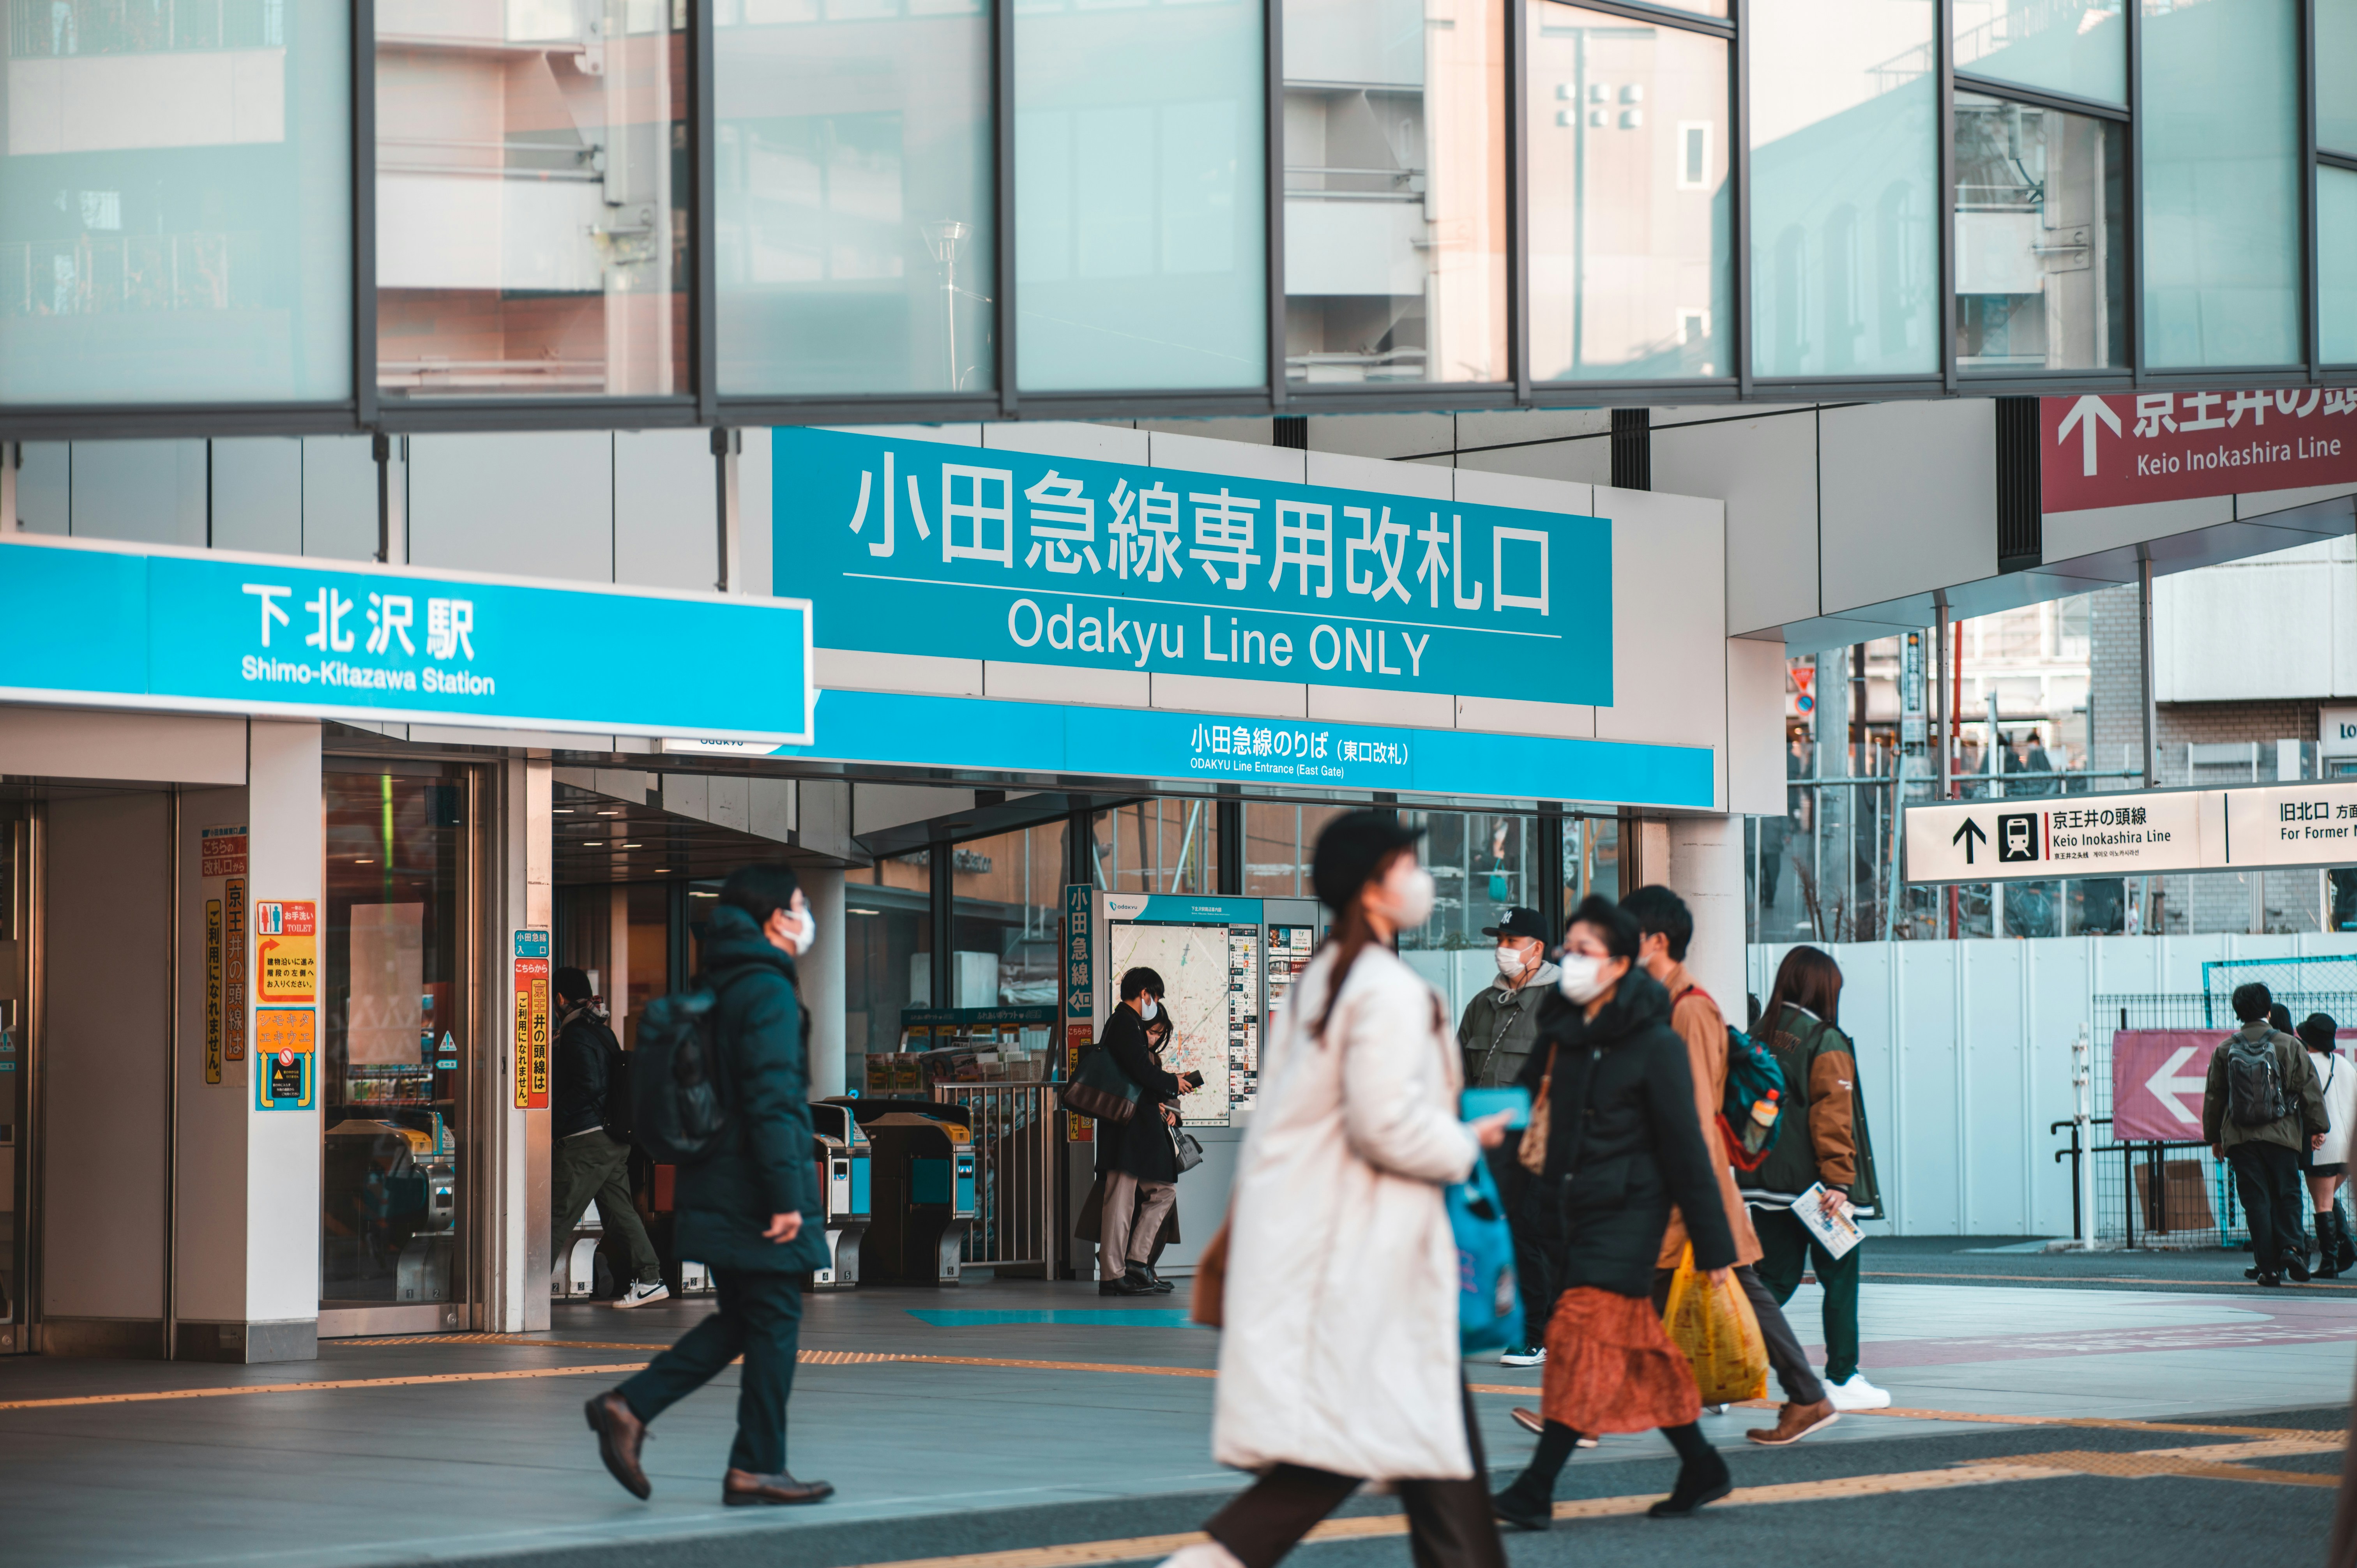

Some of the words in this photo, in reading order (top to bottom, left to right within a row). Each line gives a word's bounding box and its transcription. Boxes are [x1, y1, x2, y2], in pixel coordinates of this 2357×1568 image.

[2138, 452, 2180, 476] Keio
[2187, 441, 2290, 471] Inokashira
[2299, 436, 2341, 459] Line
[849, 451, 1549, 616] 小田急線専用改札口
[241, 582, 475, 662] 下北沢駅
[1008, 598, 1184, 668] Odakyu
[1204, 615, 1293, 667] Line
[1309, 623, 1430, 677] ONLY
[241, 654, 417, 691] Shimo-Kitazawa
[422, 666, 495, 696] Station
[1191, 723, 1329, 759] 小田急線のりば
[1190, 758, 1231, 770] ODAKYU
[1233, 761, 1252, 772] Line
[1254, 762, 1294, 774] Entrance
[1296, 764, 1318, 777] (East
[1321, 766, 1344, 779] Gate)
[2053, 806, 2147, 829] 京王井の頭線
[2280, 802, 2329, 822] 旧北口
[2053, 833, 2078, 847] Keio
[2082, 831, 2142, 846] Inokashira
[2147, 829, 2171, 842] Line
[2281, 827, 2300, 840] For
[2306, 826, 2349, 839] Former
[204, 840, 233, 855] こちらの
[2054, 851, 2089, 860] 京王井之头线
[204, 859, 244, 875] 改札口から
[284, 911, 313, 920] お手洗い
[516, 932, 547, 943] 小田急線
[1071, 887, 1089, 986] 小田急線
[228, 885, 244, 1055] 京王井の頭線は
[515, 964, 548, 973] こちらから
[208, 910, 220, 1077] ご利用になれません。
[1073, 994, 1091, 1006] 入口
[260, 1014, 309, 1027] シモキタ
[260, 1031, 311, 1045] エキウエ
[533, 982, 546, 1089] 京王井の頭線は
[518, 998, 528, 1104] ご利用になれません。
[408, 1290, 412, 1298] 1
[434, 1289, 439, 1297] 2
